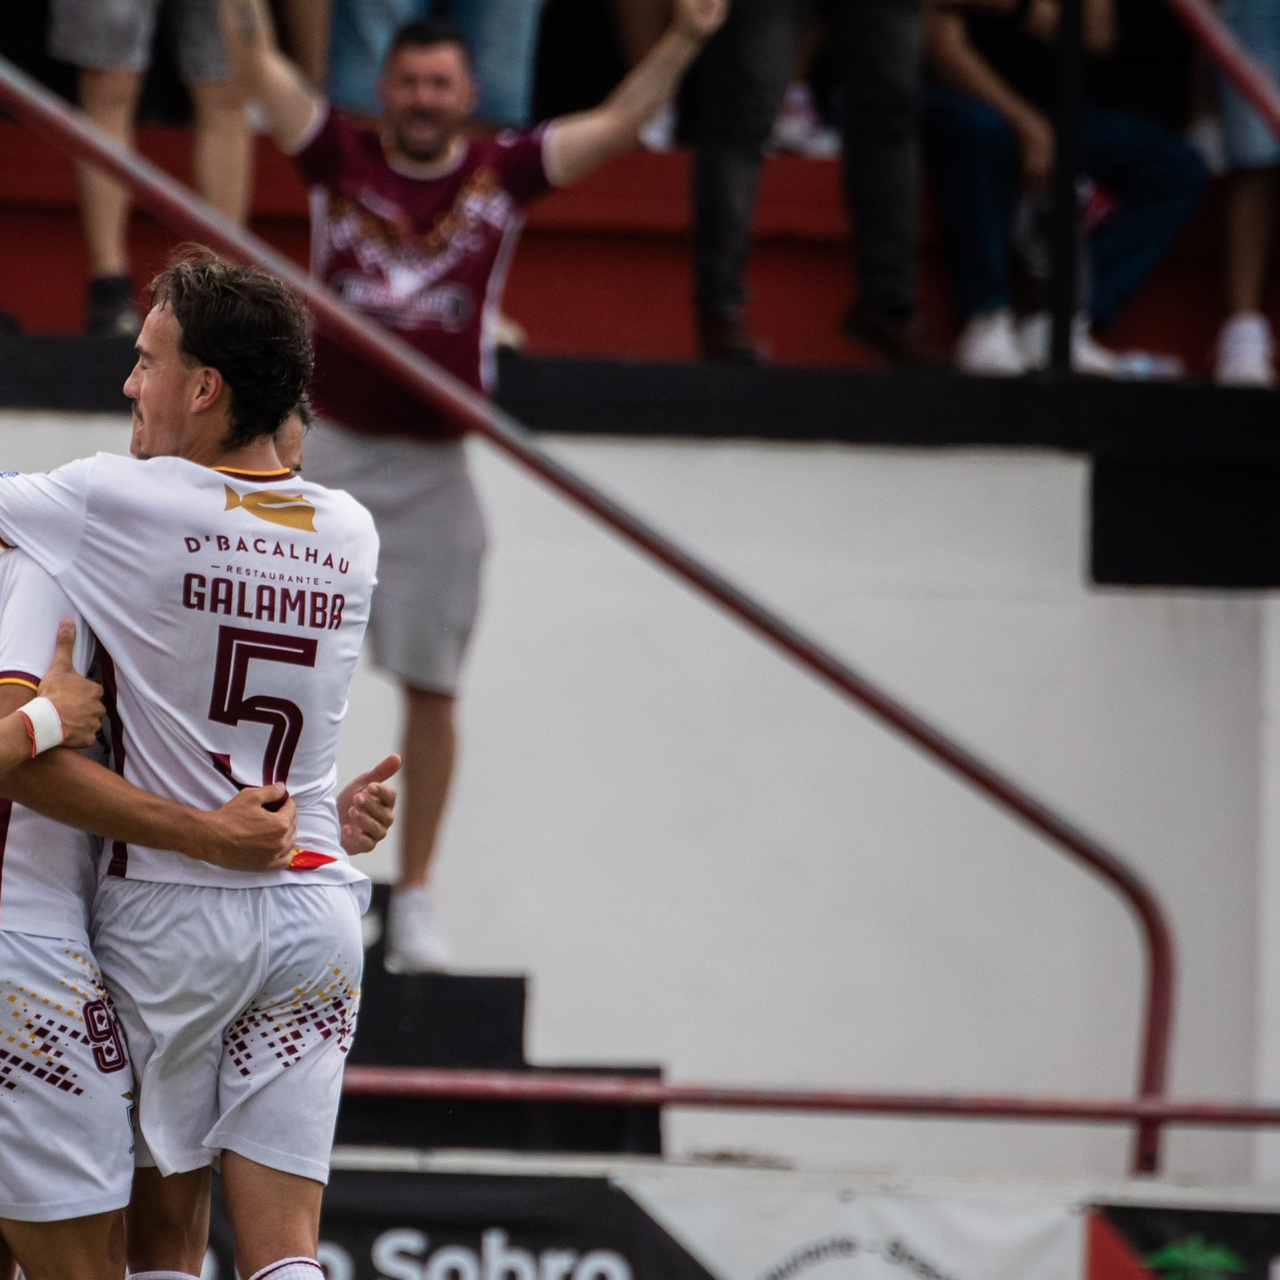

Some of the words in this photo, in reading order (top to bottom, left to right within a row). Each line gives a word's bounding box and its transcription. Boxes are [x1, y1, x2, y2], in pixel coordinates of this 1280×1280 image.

[184, 535, 350, 574] D'BACALHAU
[227, 565, 320, 585] RESTAURANTE
[183, 573, 345, 630] GALAMBA
[207, 625, 319, 811] 5
